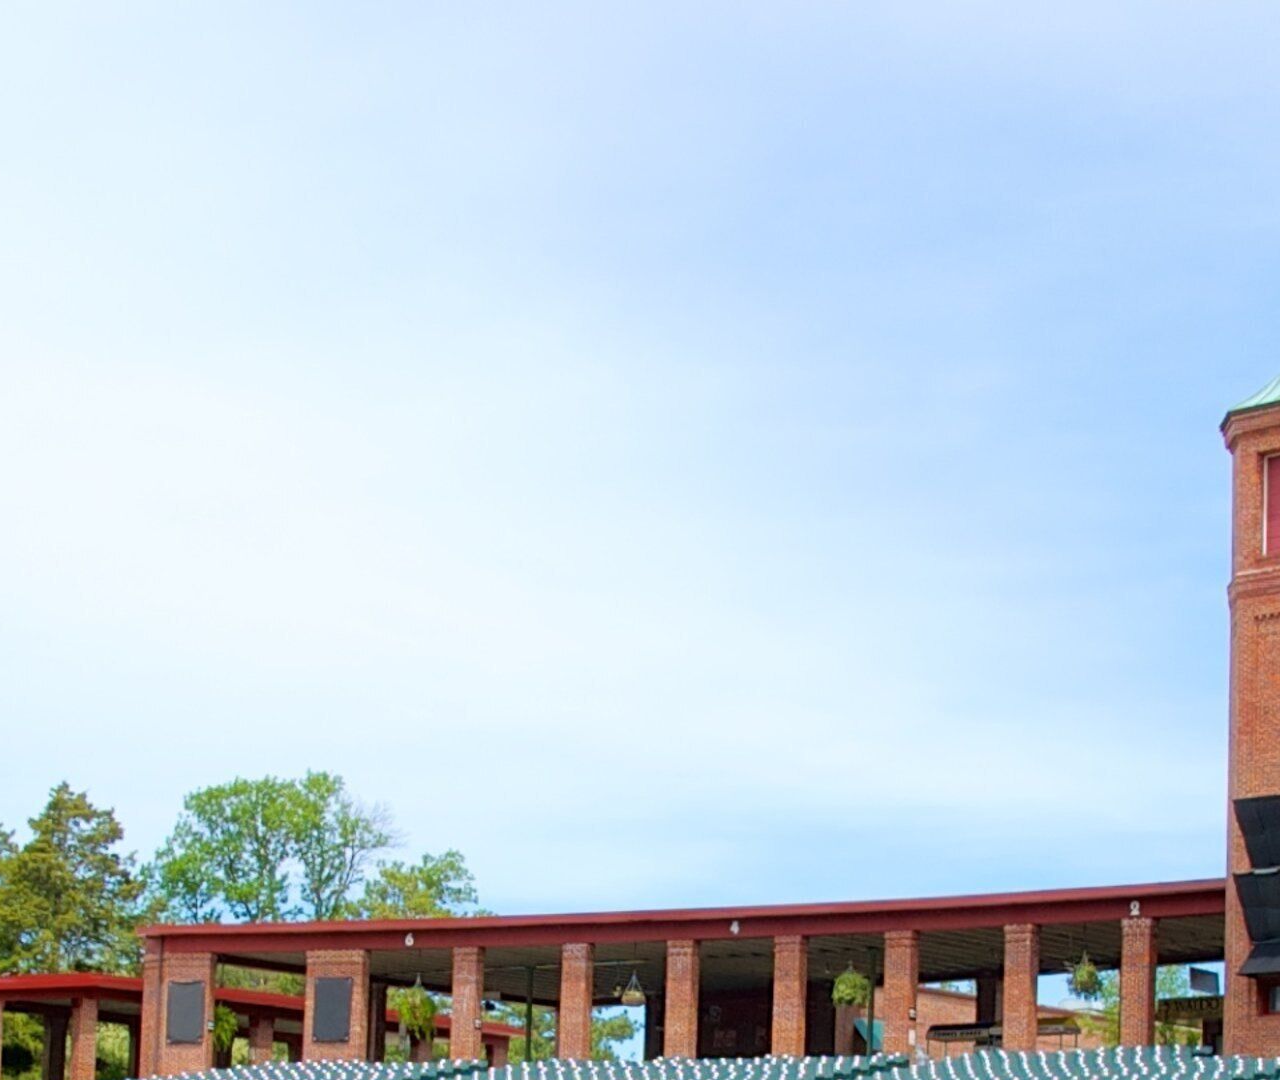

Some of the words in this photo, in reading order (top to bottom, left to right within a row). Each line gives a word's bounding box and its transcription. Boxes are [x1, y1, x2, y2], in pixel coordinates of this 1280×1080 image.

[1129, 900, 1140, 916] 2
[730, 920, 739, 935] 4
[405, 932, 414, 946] 6
